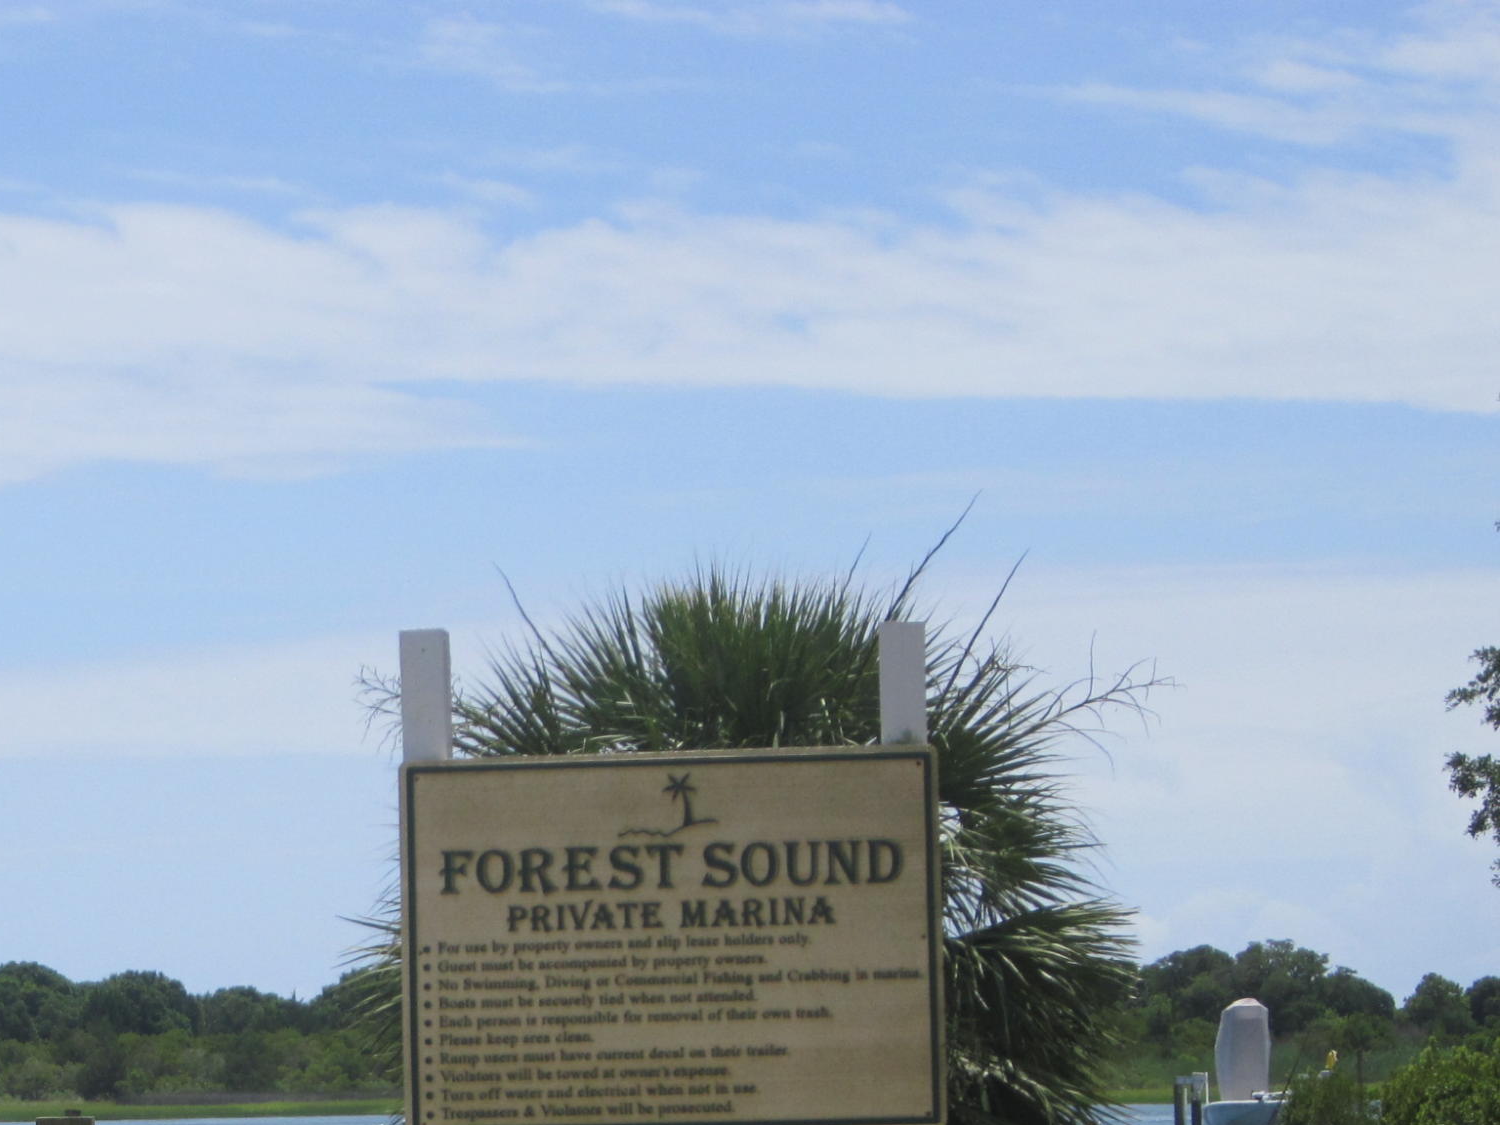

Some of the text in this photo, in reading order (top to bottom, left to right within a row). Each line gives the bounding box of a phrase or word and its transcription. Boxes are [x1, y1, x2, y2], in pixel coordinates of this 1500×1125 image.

[439, 839, 904, 895] FOREST SOUND
[507, 896, 836, 933] PRIVATE MARINA
[438, 942, 460, 954] For
[465, 944, 487, 953] use
[492, 940, 508, 955] by
[513, 940, 570, 955] property
[575, 939, 623, 950] owners
[628, 937, 651, 949] and
[656, 935, 681, 950] slip
[687, 936, 719, 947] lease
[724, 934, 774, 946] holders
[438, 954, 768, 973] Guest must be accompanied by property owners.
[438, 979, 459, 991] No
[545, 976, 591, 989] Diving
[596, 977, 610, 986] or
[703, 972, 753, 985] Fishing
[759, 971, 782, 982] and
[787, 969, 850, 984] Crabbing
[856, 969, 868, 980] in
[873, 969, 923, 980] marina.
[439, 990, 758, 1009] Boats must be securely tied when not attended.
[439, 1015, 472, 1029] Each
[477, 1016, 521, 1031] person
[526, 1015, 537, 1026] is
[542, 1012, 619, 1027] responsible
[623, 1011, 642, 1022] for
[648, 1010, 703, 1022] removal
[708, 1010, 723, 1021] of
[727, 1008, 758, 1020] their
[762, 1009, 791, 1019] own
[439, 1032, 595, 1047] Please keep area clean.
[439, 1053, 480, 1067] Ramp
[484, 1053, 518, 1063] users
[523, 1052, 556, 1062] must
[560, 1050, 592, 1061] have
[596, 1050, 644, 1061] current
[689, 1048, 706, 1057] on
[711, 1046, 741, 1057] their
[440, 1070, 501, 1083] Violators
[507, 1068, 532, 1080] will
[537, 1068, 552, 1080] be
[556, 1068, 598, 1080] towed
[603, 1068, 615, 1079] at
[673, 1067, 731, 1079] expense.
[441, 1089, 474, 1101] Turn
[479, 1087, 502, 1099] off
[505, 1088, 543, 1099] water
[548, 1087, 573, 1099] and
[577, 1085, 642, 1098] electrical
[646, 1084, 684, 1095] when
[688, 1084, 711, 1094] not
[716, 1083, 729, 1094] in
[441, 1107, 519, 1121] Trespassers
[541, 1104, 602, 1117] Violators
[607, 1102, 633, 1115] will
[638, 1103, 654, 1114] be
[658, 1101, 735, 1116] prosecuted.
